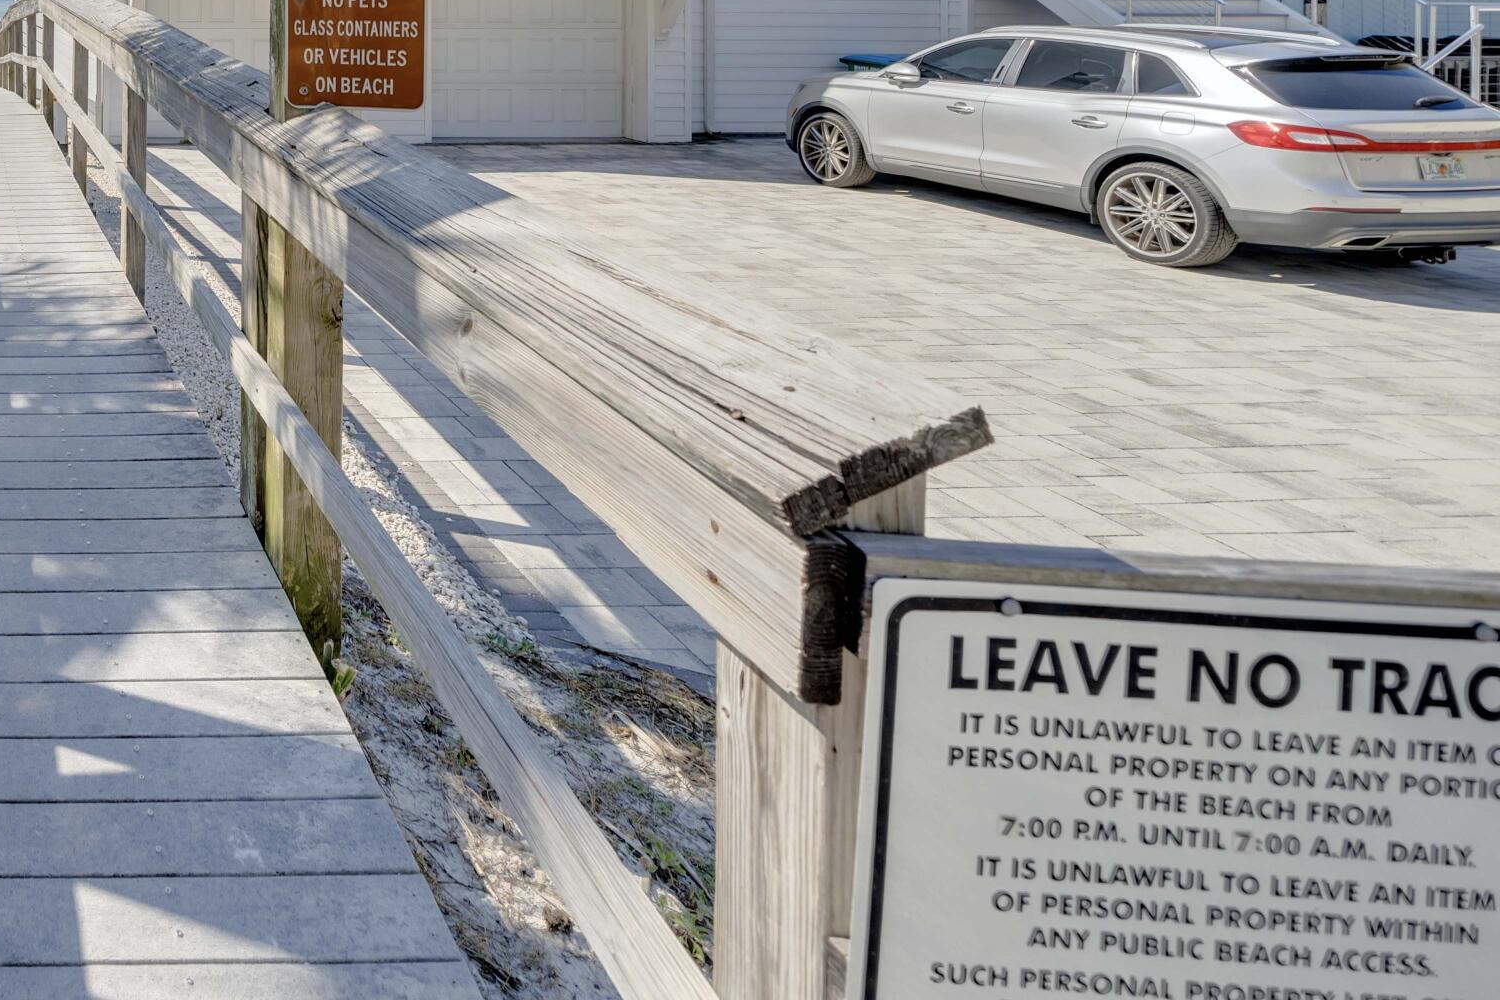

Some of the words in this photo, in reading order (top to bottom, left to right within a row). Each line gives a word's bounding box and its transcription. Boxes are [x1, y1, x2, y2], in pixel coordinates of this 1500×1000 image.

[294, 19, 334, 36] GLASS
[337, 20, 419, 38] CONTAINERS
[303, 48, 324, 65] OR
[328, 48, 407, 67] VEHICLES
[315, 76, 337, 93] ON
[341, 77, 394, 95] BEACH
[948, 635, 1157, 699] LEAVE
[1188, 649, 1300, 709] NO
[960, 712, 984, 734] IT
[994, 714, 1019, 736] IS
[1030, 715, 1192, 747] UNLAWFUL
[1203, 727, 1242, 749] TO
[1253, 729, 1341, 756] LEAVE
[1350, 736, 1396, 760] AN
[1407, 738, 1477, 765] ITEM
[947, 745, 1099, 774] PERSONAL
[1109, 753, 1258, 785] PROPERTY
[1268, 764, 1316, 788] ON
[1325, 768, 1390, 792] ANY
[1084, 786, 1124, 809] OF
[1132, 788, 1188, 814] THE
[1199, 793, 1296, 821] BEACH
[1306, 801, 1393, 827] FROM
[1000, 816, 1062, 839] 7:00
[1073, 819, 1127, 844] P.M.
[1138, 823, 1227, 851] UNTIL
[1234, 831, 1301, 856] 7:00
[1309, 835, 1376, 861] A.M.
[1387, 840, 1477, 868] DAILY.
[976, 855, 1000, 877] IT
[1011, 857, 1036, 880] IS
[1047, 859, 1210, 891] UNLAWFUL
[1220, 870, 1260, 895] TO
[1270, 874, 1360, 902] LEAVE
[1369, 882, 1415, 906] AN
[1425, 884, 1496, 912] ITEM
[991, 890, 1030, 912] OF
[1040, 892, 1195, 925] PERSONAL
[1205, 904, 1355, 936] PROPERTY
[1363, 916, 1480, 945] WITHIN
[1027, 926, 1091, 950] ANY
[1100, 930, 1204, 960] PUBLIC
[1214, 939, 1312, 967] BEACH
[1320, 948, 1439, 979] ACCESS.
[929, 961, 1008, 986] SUCH
[1020, 967, 1172, 1000] PERSONAL
